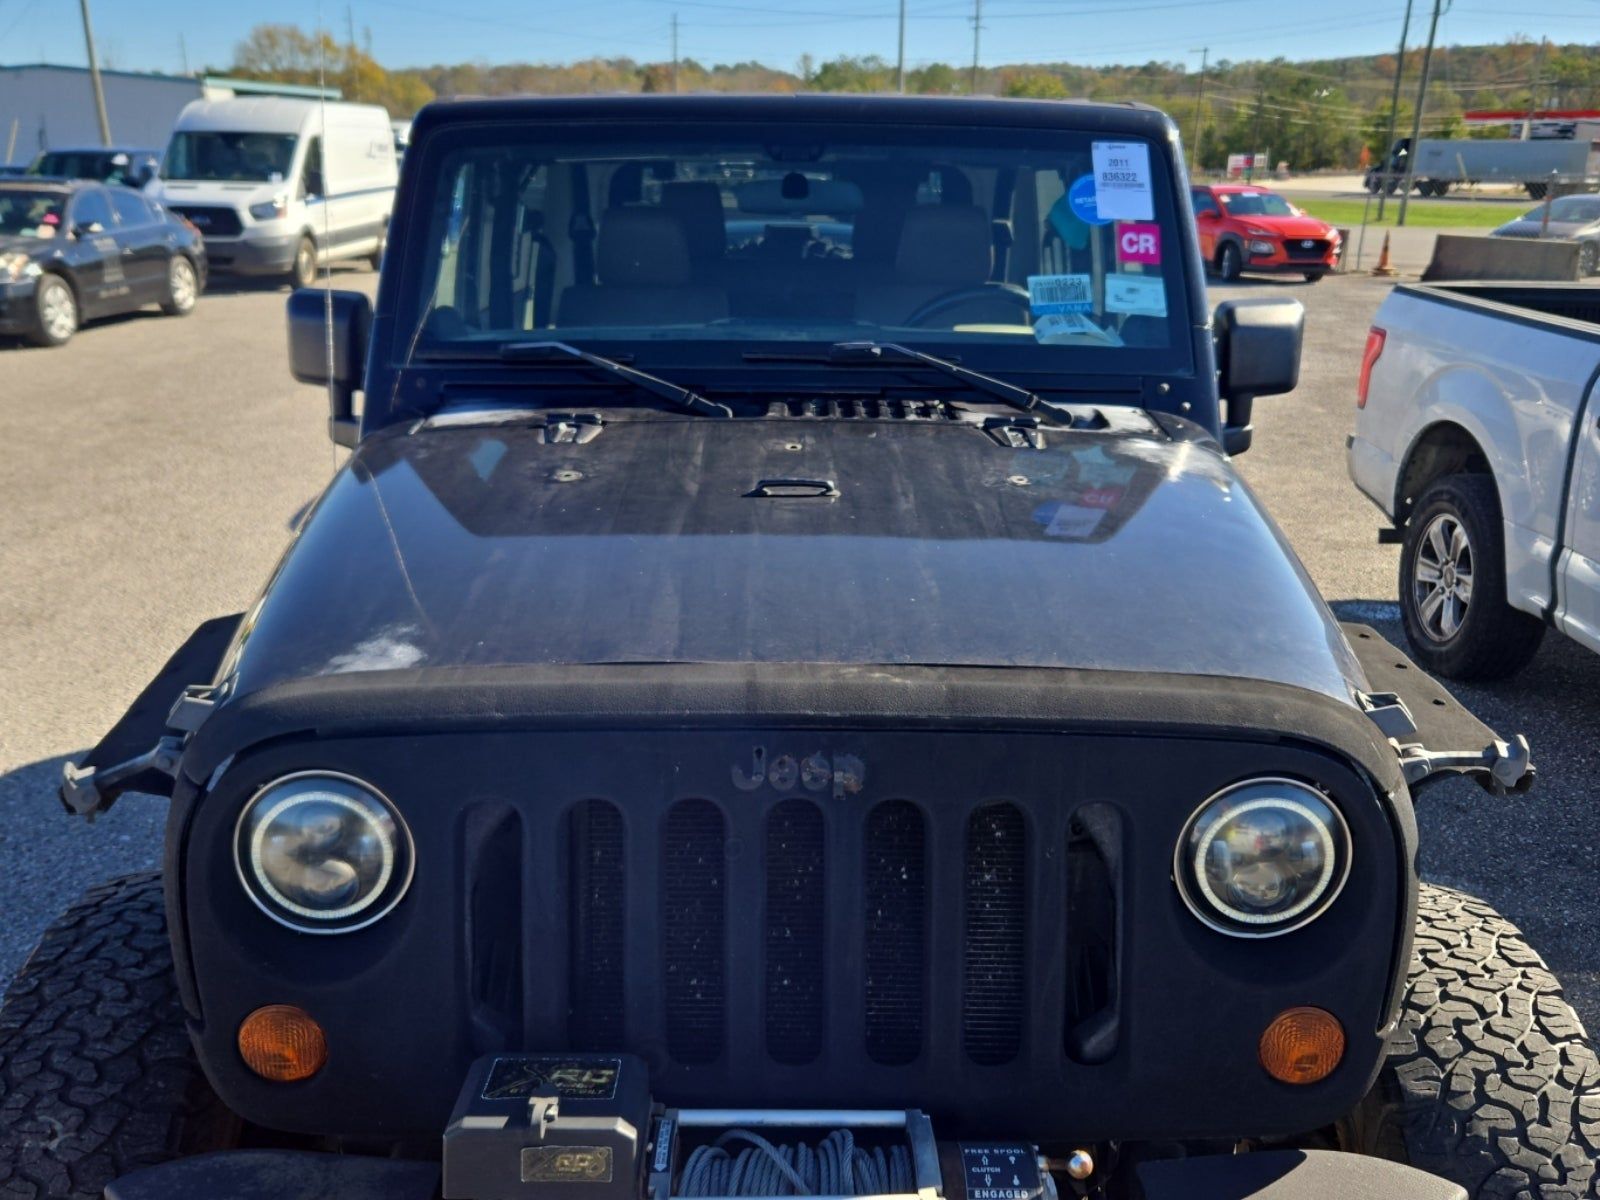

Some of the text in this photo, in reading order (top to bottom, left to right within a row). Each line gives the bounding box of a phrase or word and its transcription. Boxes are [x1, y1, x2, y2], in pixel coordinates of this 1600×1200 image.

[1108, 158, 1129, 167] 2011
[1102, 172, 1137, 182] 836322
[1121, 232, 1156, 254] CR
[974, 1189, 1029, 1199] ENGAGED
